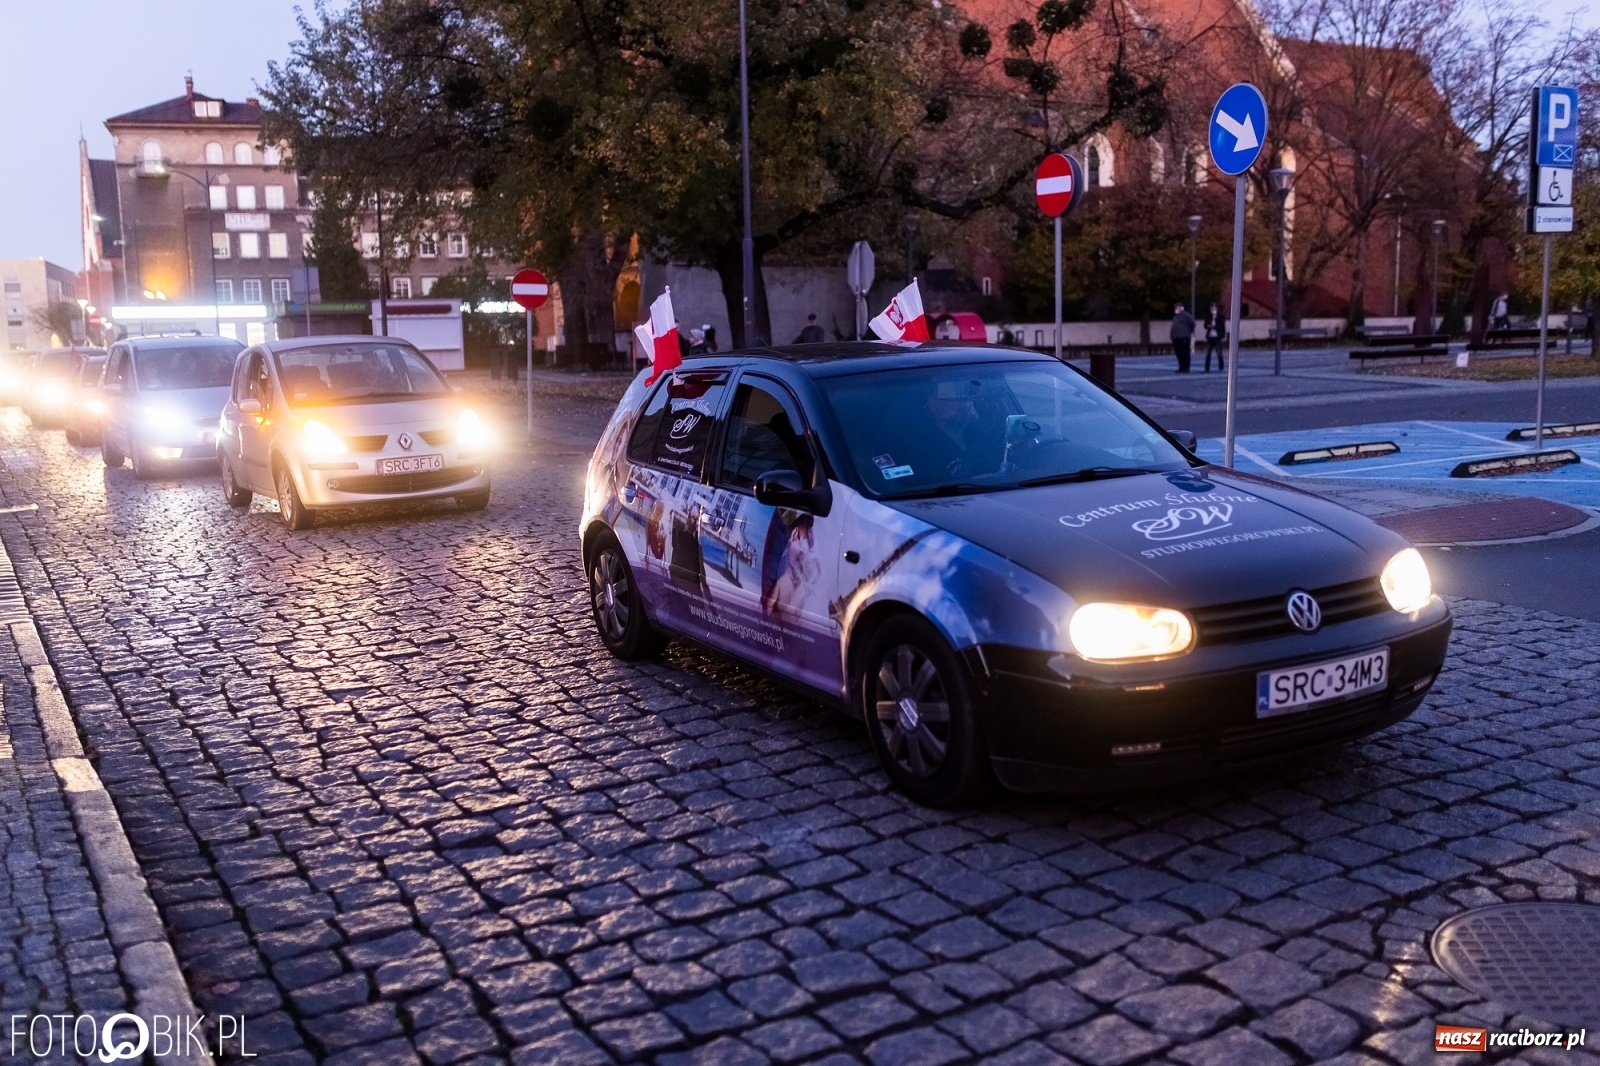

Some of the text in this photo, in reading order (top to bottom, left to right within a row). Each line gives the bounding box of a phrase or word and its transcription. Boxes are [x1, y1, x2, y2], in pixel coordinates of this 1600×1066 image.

[1548, 93, 1571, 142] P
[1537, 216, 1542, 224] 2
[385, 456, 441, 472] SRC 3FT6
[1058, 491, 1259, 528] Centrum Ślubne
[1140, 525, 1325, 559] STUDIOWEGOROWSKI.PL
[688, 603, 785, 653] www.studiowegorowski.pl
[1274, 655, 1384, 705] SRC 34M3
